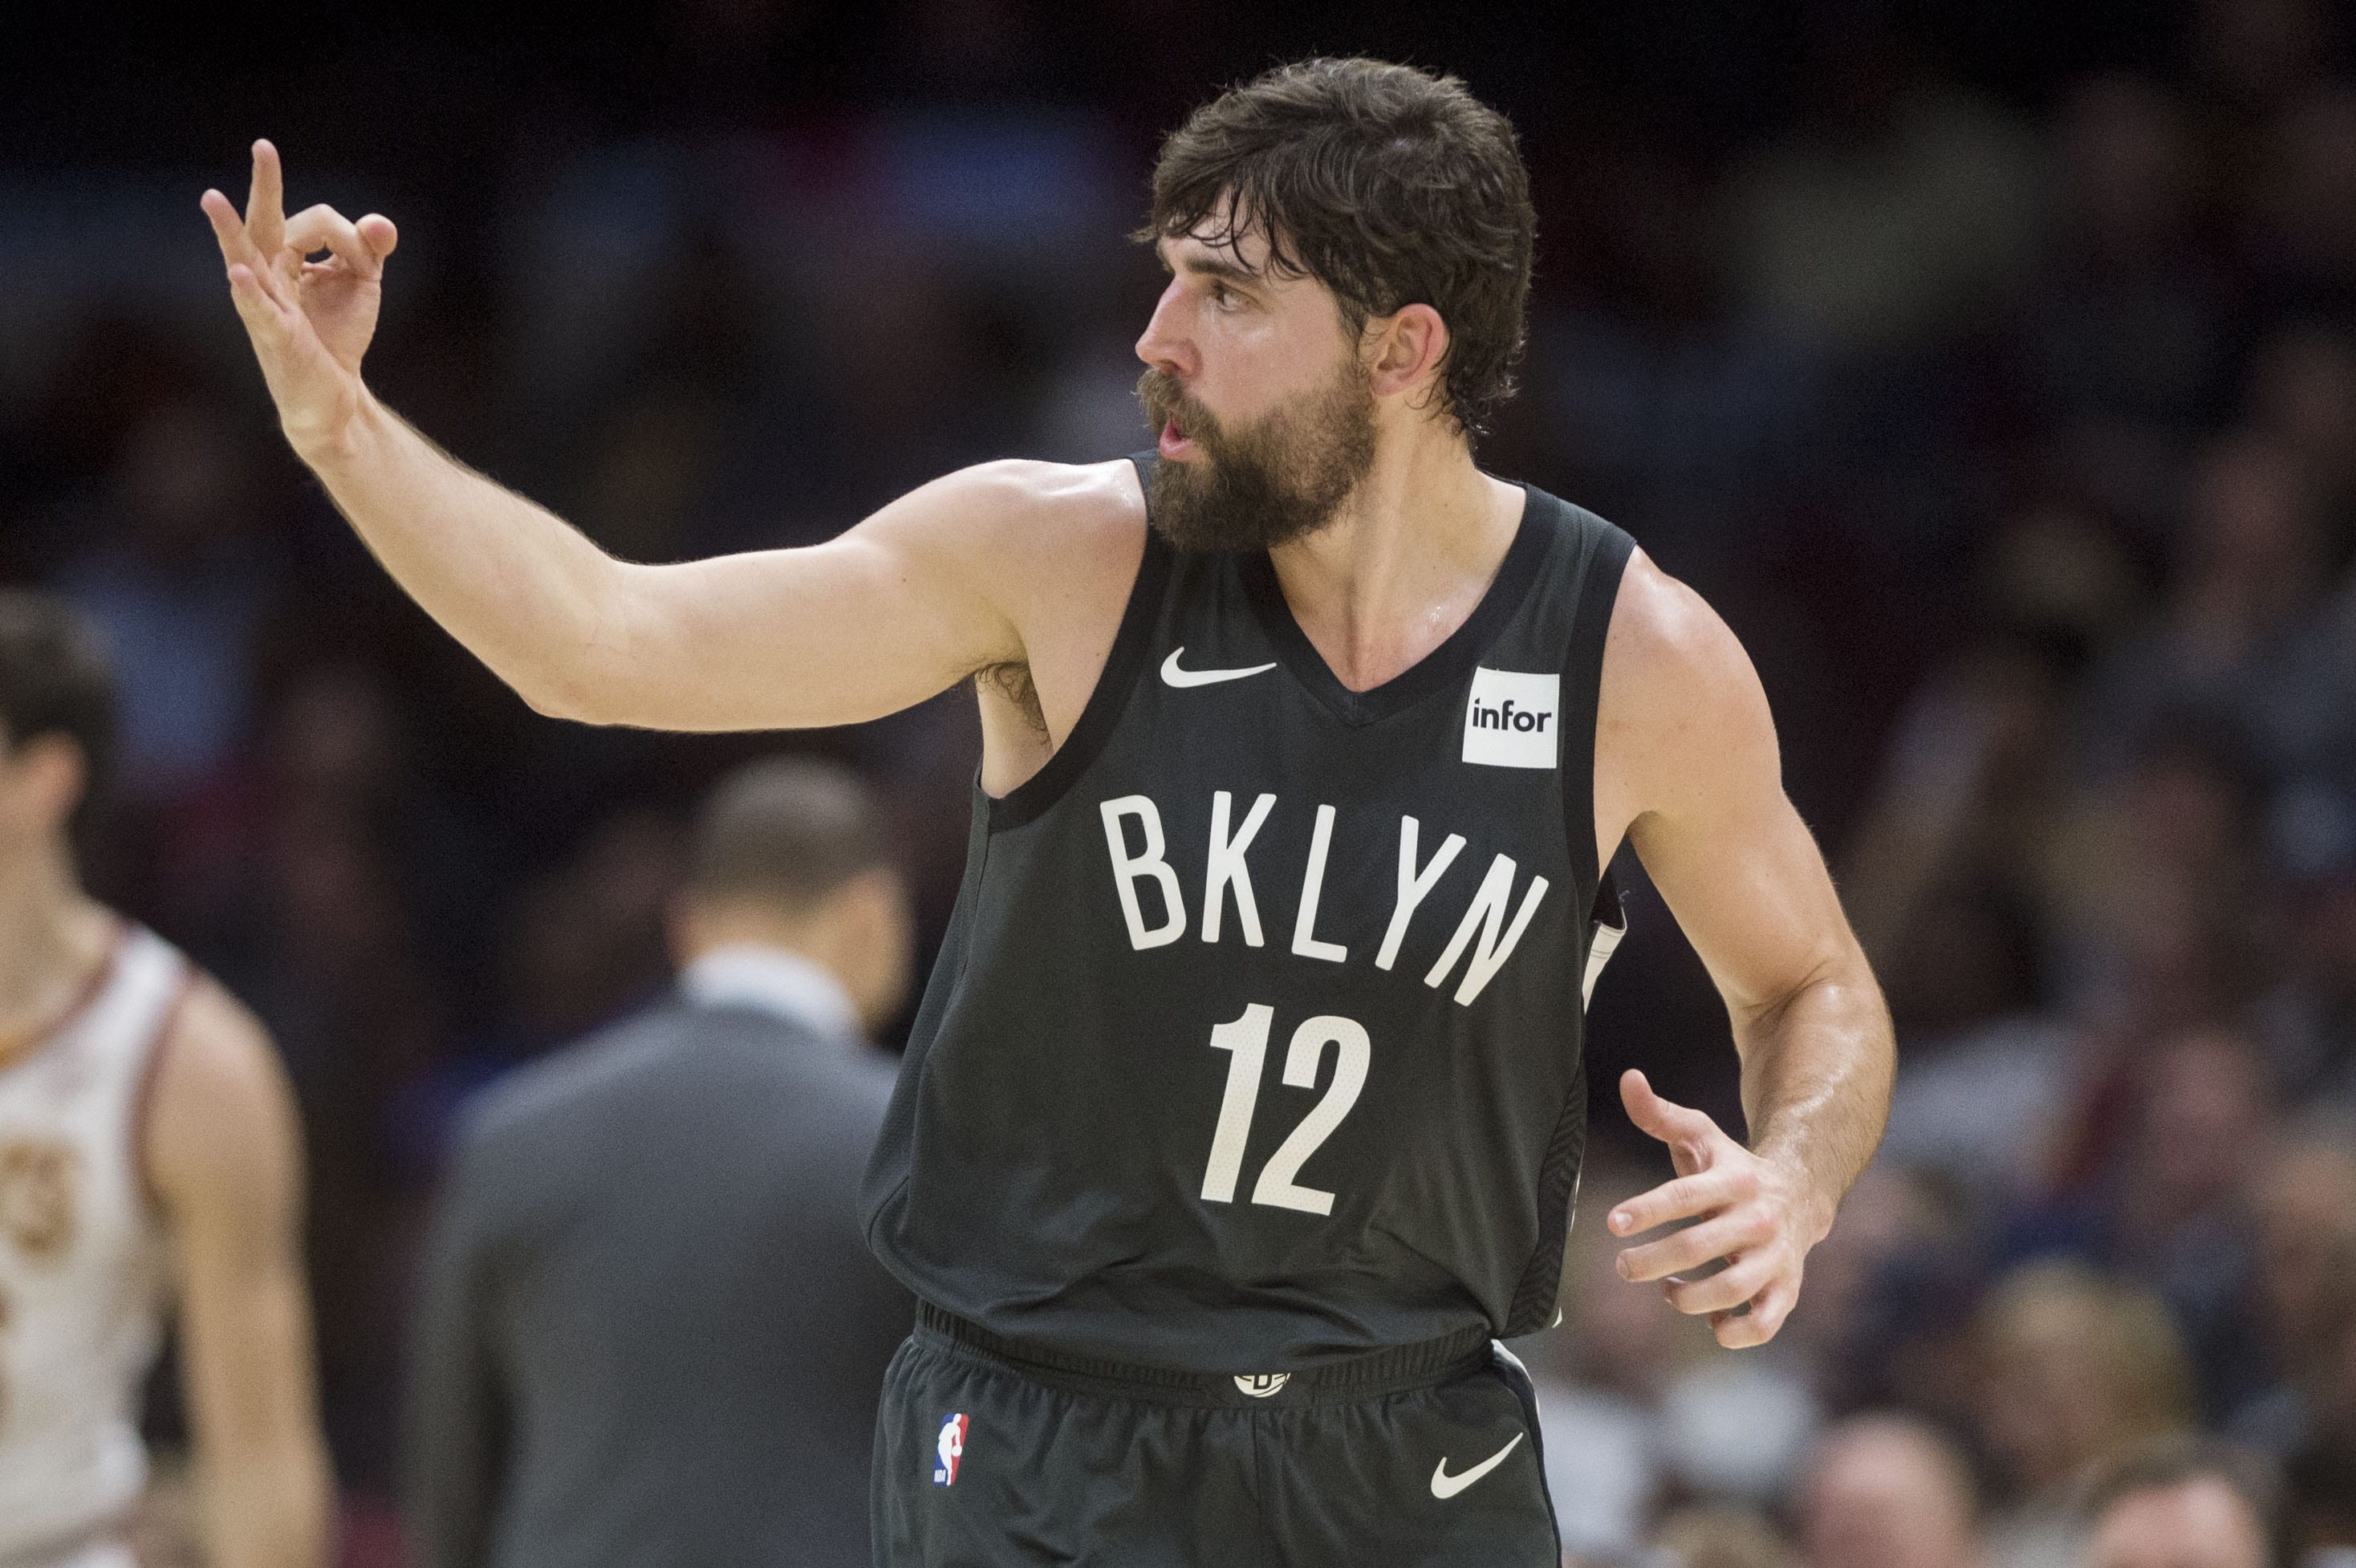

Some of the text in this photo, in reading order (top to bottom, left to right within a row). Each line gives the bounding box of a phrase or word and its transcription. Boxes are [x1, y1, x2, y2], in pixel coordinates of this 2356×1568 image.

[1472, 697, 1552, 733] infor
[1100, 790, 1550, 1006] BKLYN
[1200, 1003, 1371, 1217] 12
